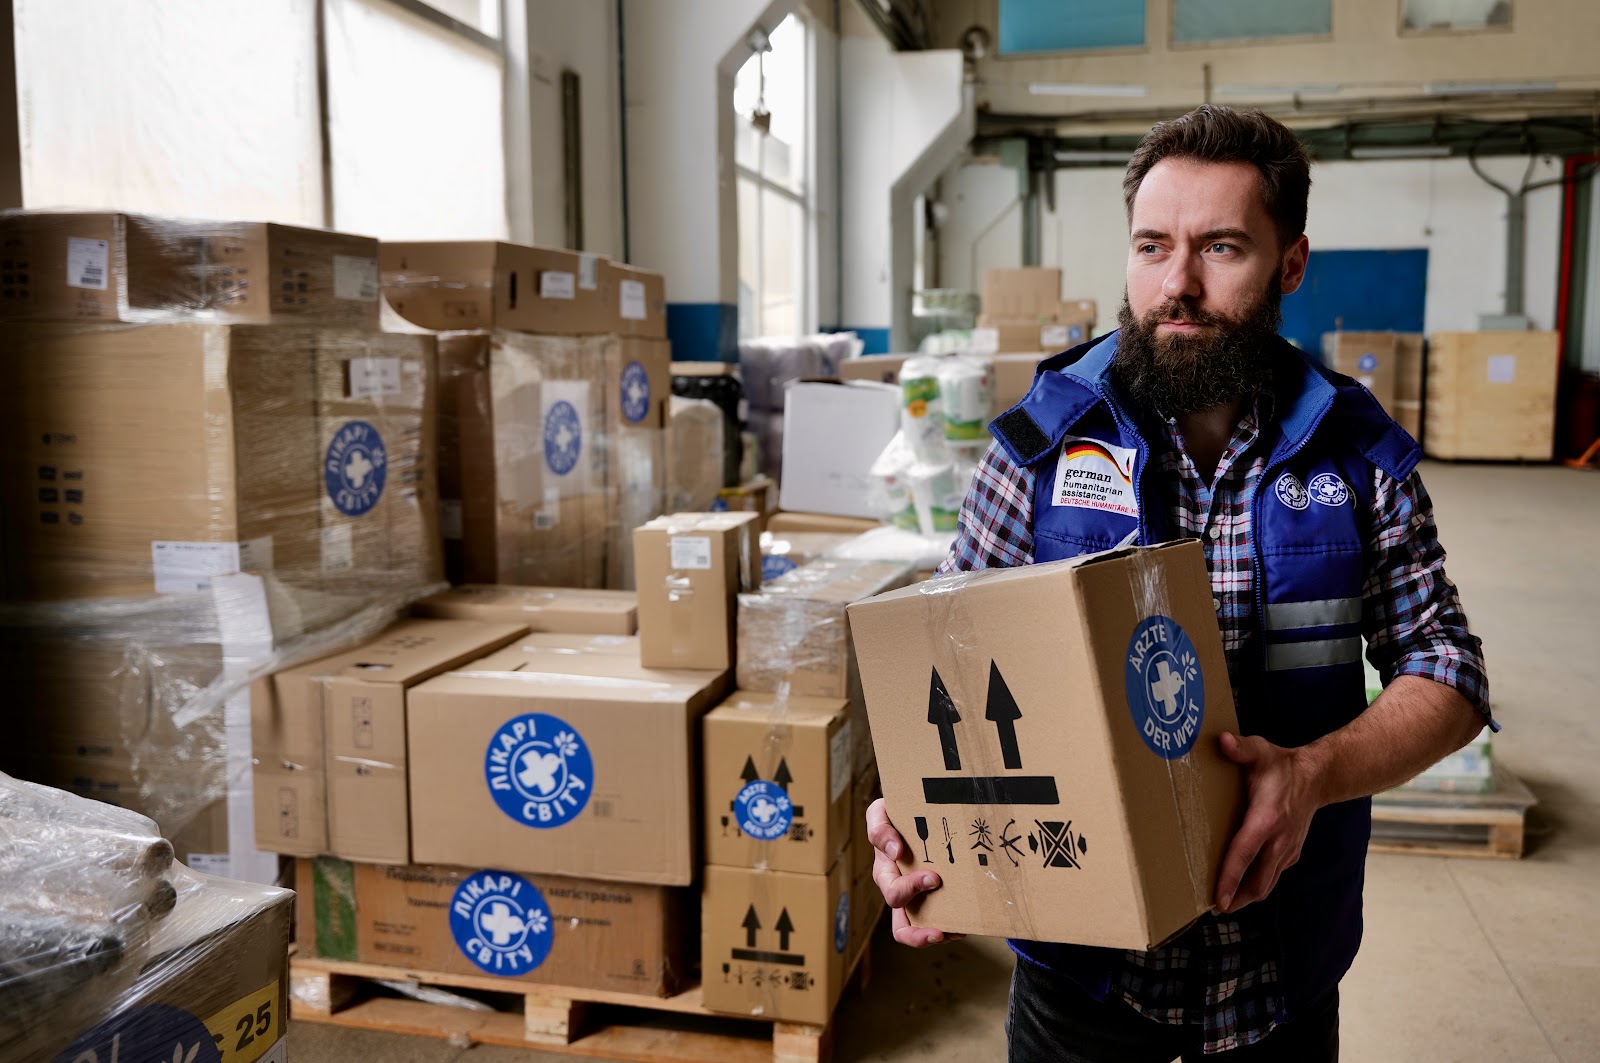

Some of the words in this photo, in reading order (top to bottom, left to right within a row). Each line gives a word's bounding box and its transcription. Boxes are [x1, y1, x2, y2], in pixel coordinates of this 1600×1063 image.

[1061, 489, 1107, 501] assistance
[1063, 480, 1123, 496] humanitarian
[1064, 468, 1112, 483] german
[1060, 497, 1090, 506] DEUTSCHE
[1091, 500, 1130, 513] HUMANITÄRE
[1316, 494, 1332, 504] DER
[1128, 624, 1168, 674] ÄRZTE
[1143, 716, 1171, 751] DER
[1172, 697, 1200, 749] WELT
[489, 718, 537, 791] ЛІКАРІ
[522, 773, 586, 822] СВІТУ
[454, 874, 522, 920] ЛІКАРІ
[465, 937, 534, 970] СВІТУ
[235, 1000, 272, 1052] 25
